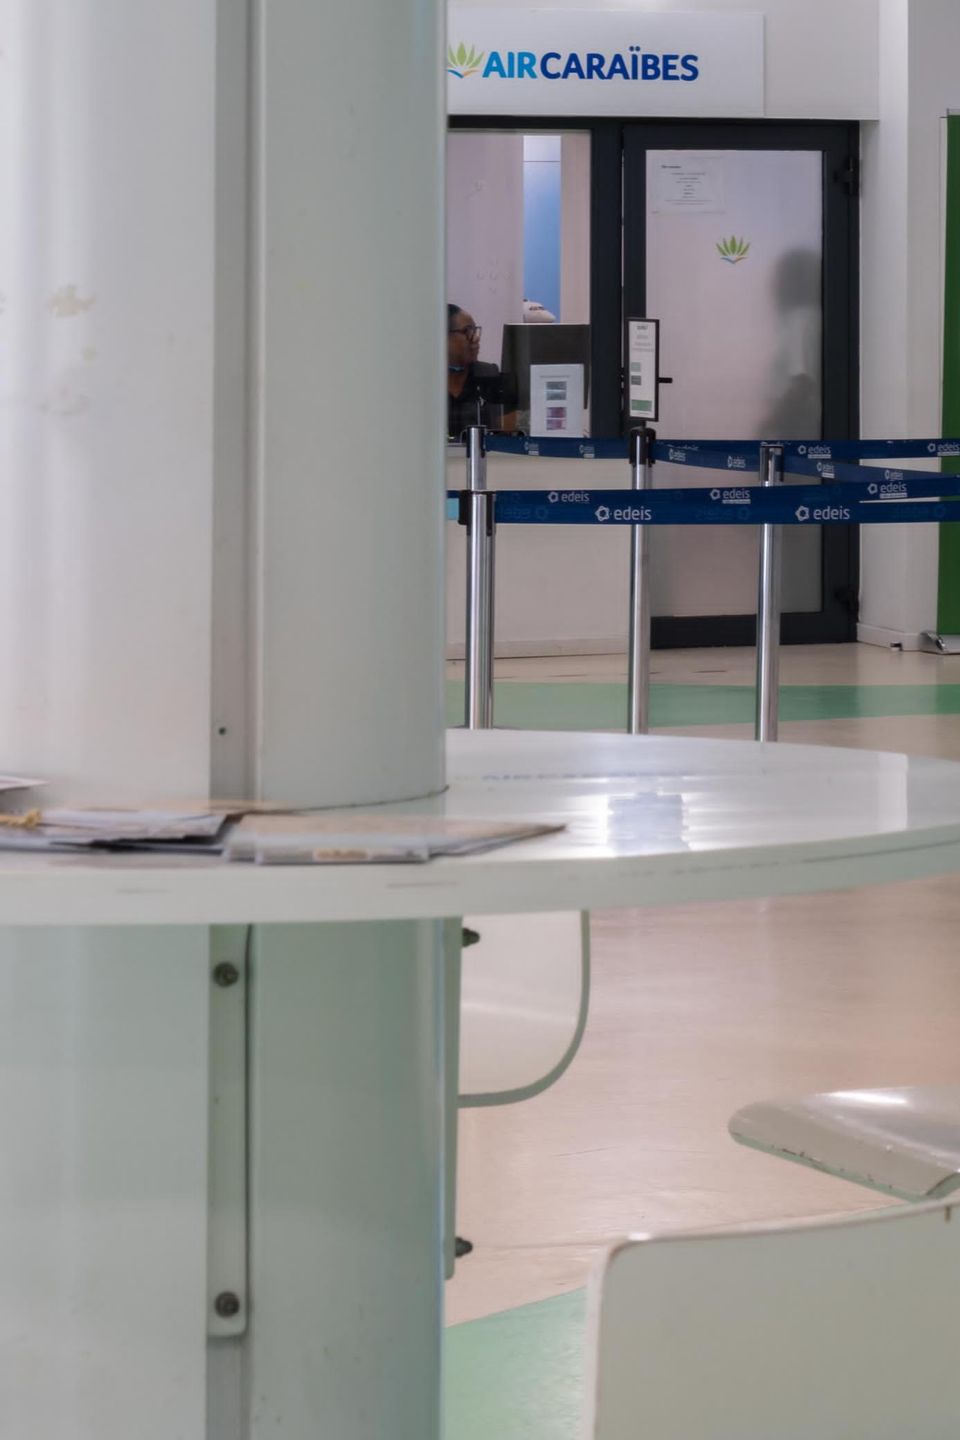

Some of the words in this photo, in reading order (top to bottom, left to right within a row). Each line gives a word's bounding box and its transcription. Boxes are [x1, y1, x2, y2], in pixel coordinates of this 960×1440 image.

[482, 51, 538, 79] AIR
[540, 46, 699, 81] CARAÏBES
[808, 445, 831, 454] edeis
[938, 442, 960, 452] edeis
[880, 481, 907, 493] edeis
[561, 491, 590, 502] edeis
[723, 488, 750, 499] edeis
[613, 505, 652, 521] edeis
[813, 505, 850, 520] edeis
